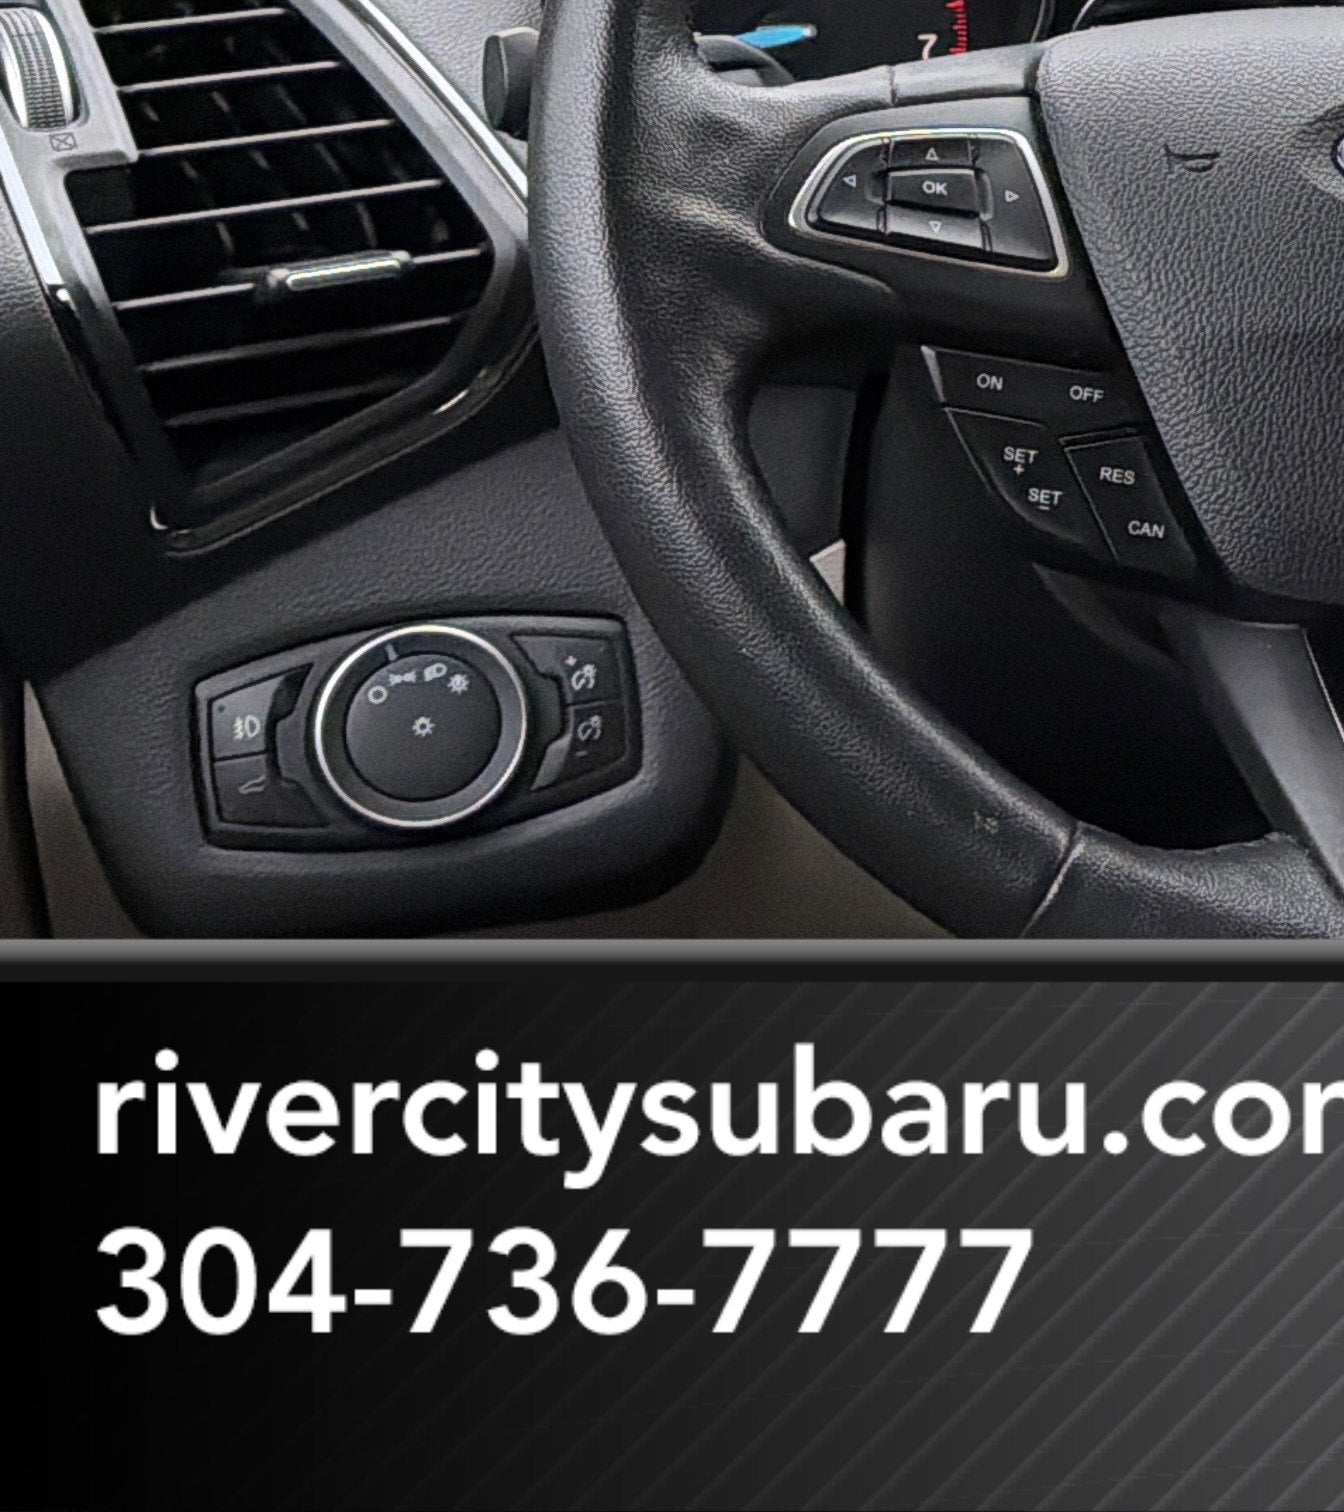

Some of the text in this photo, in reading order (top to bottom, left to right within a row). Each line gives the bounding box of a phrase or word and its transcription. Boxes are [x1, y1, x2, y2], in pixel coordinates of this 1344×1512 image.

[916, 33, 938, 62] 7
[921, 180, 949, 197] OK
[976, 373, 1104, 404] ON OFF
[1003, 445, 1039, 464] SET
[1099, 466, 1136, 486] RES
[1028, 488, 1063, 506] SET
[1127, 519, 1165, 539] CAN
